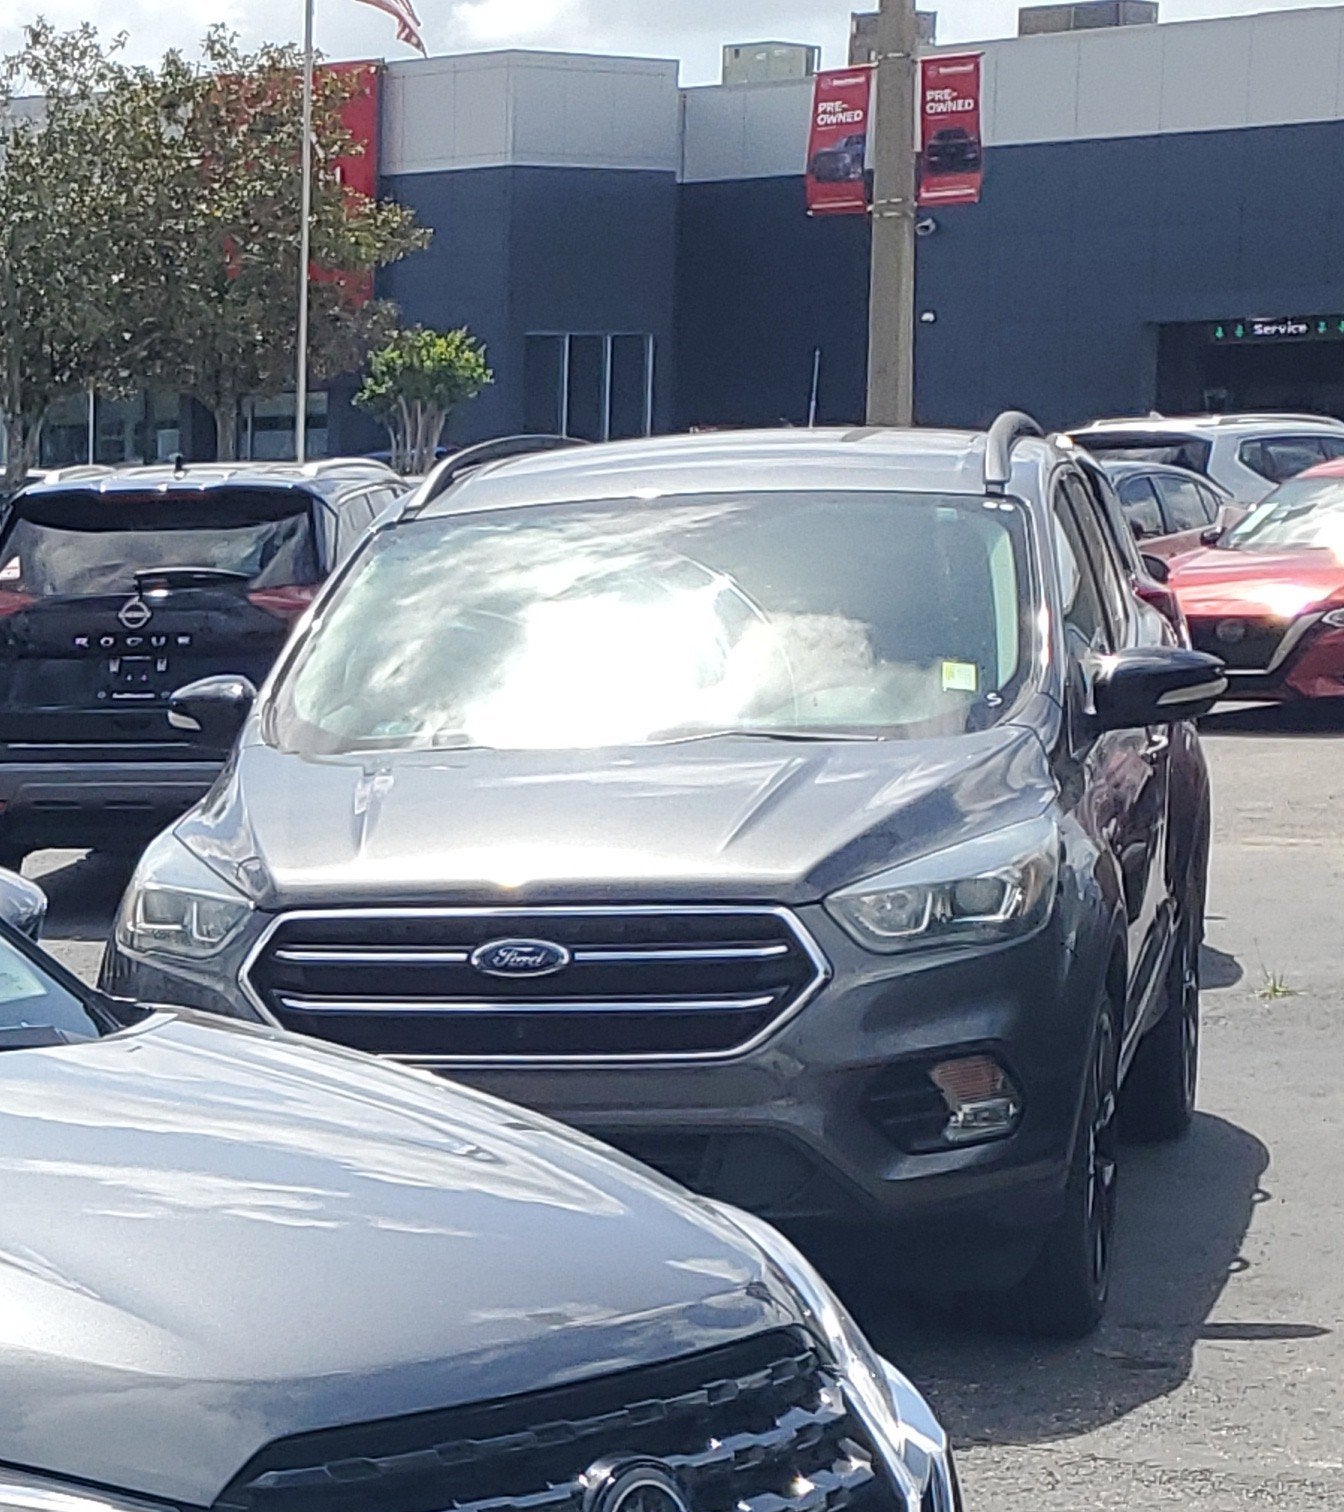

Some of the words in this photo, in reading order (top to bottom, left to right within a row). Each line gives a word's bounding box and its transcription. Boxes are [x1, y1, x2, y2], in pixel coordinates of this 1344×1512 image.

[925, 99, 974, 114] OWNED
[816, 110, 863, 126] OWNED
[1253, 321, 1308, 336] Service
[74, 636, 191, 648] ROGUE
[492, 945, 547, 968] Ford
